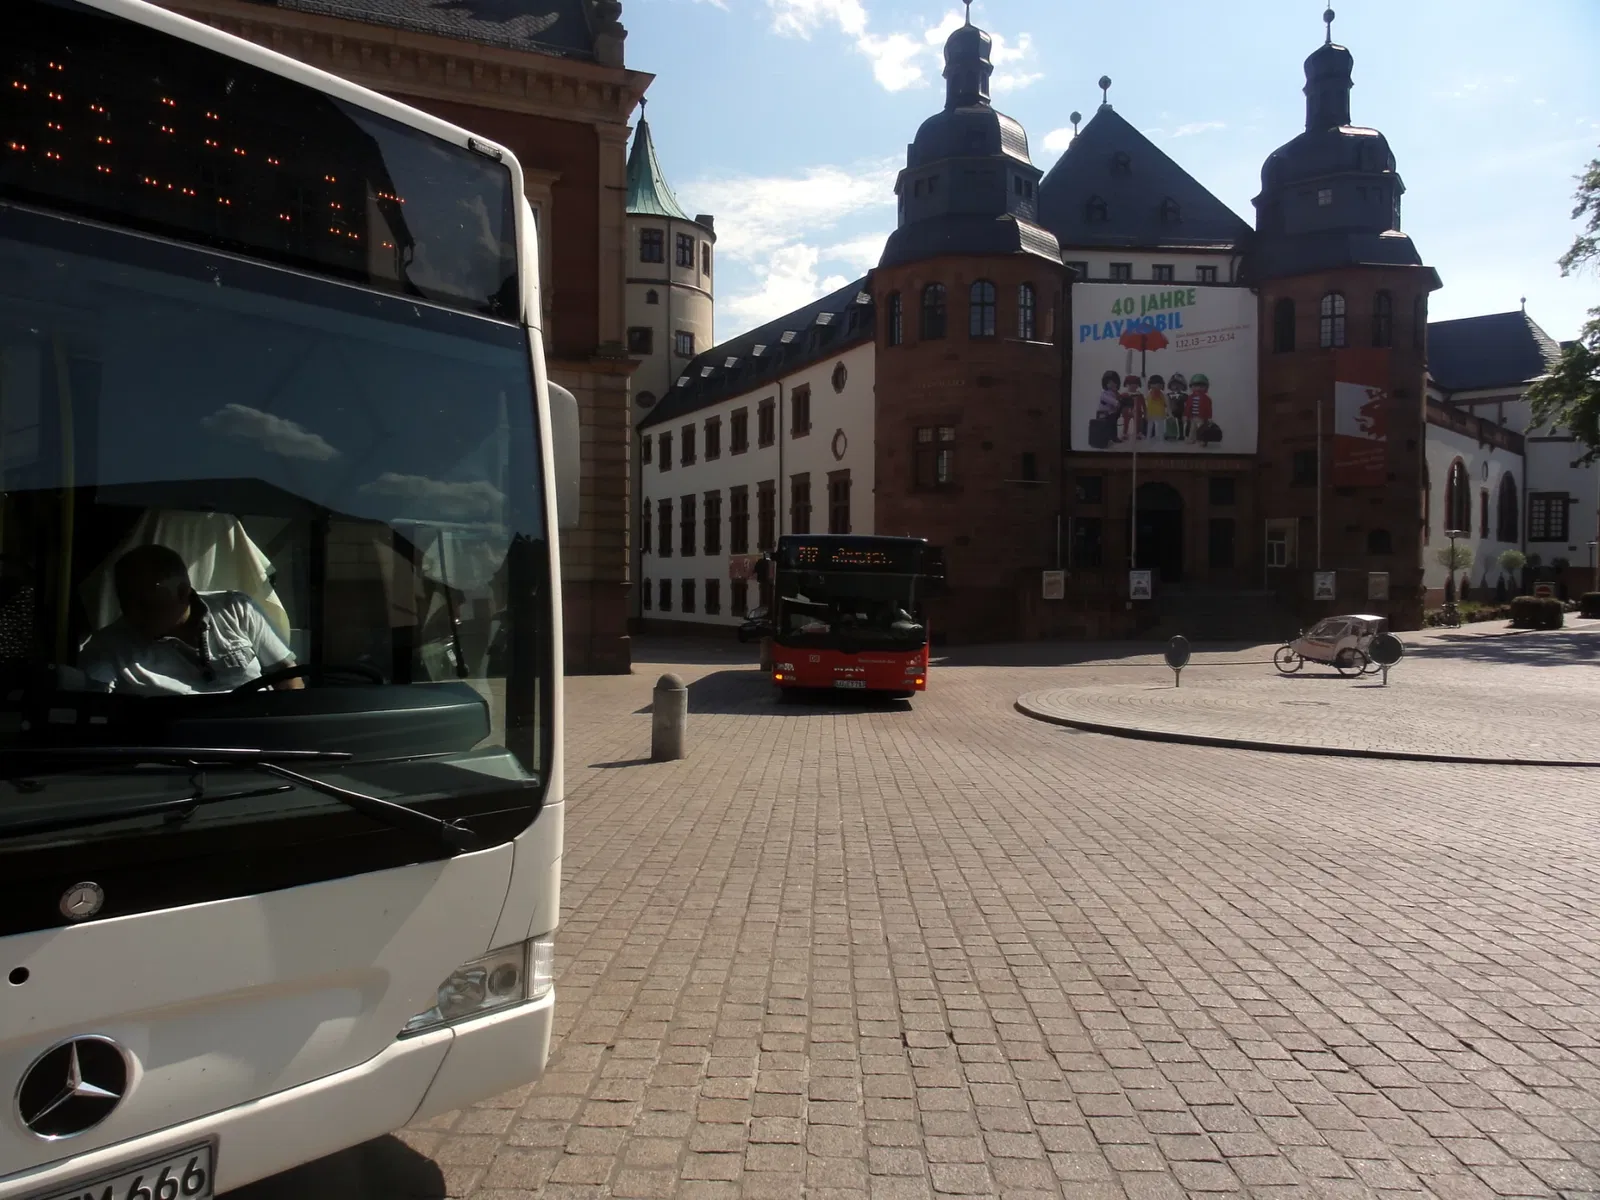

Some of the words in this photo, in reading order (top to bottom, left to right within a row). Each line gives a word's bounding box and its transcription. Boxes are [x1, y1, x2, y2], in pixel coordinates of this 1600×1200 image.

[1111, 297, 1135, 316] 40
[1140, 288, 1197, 316] JAHRE
[1079, 311, 1184, 343] PLAYMOBIL
